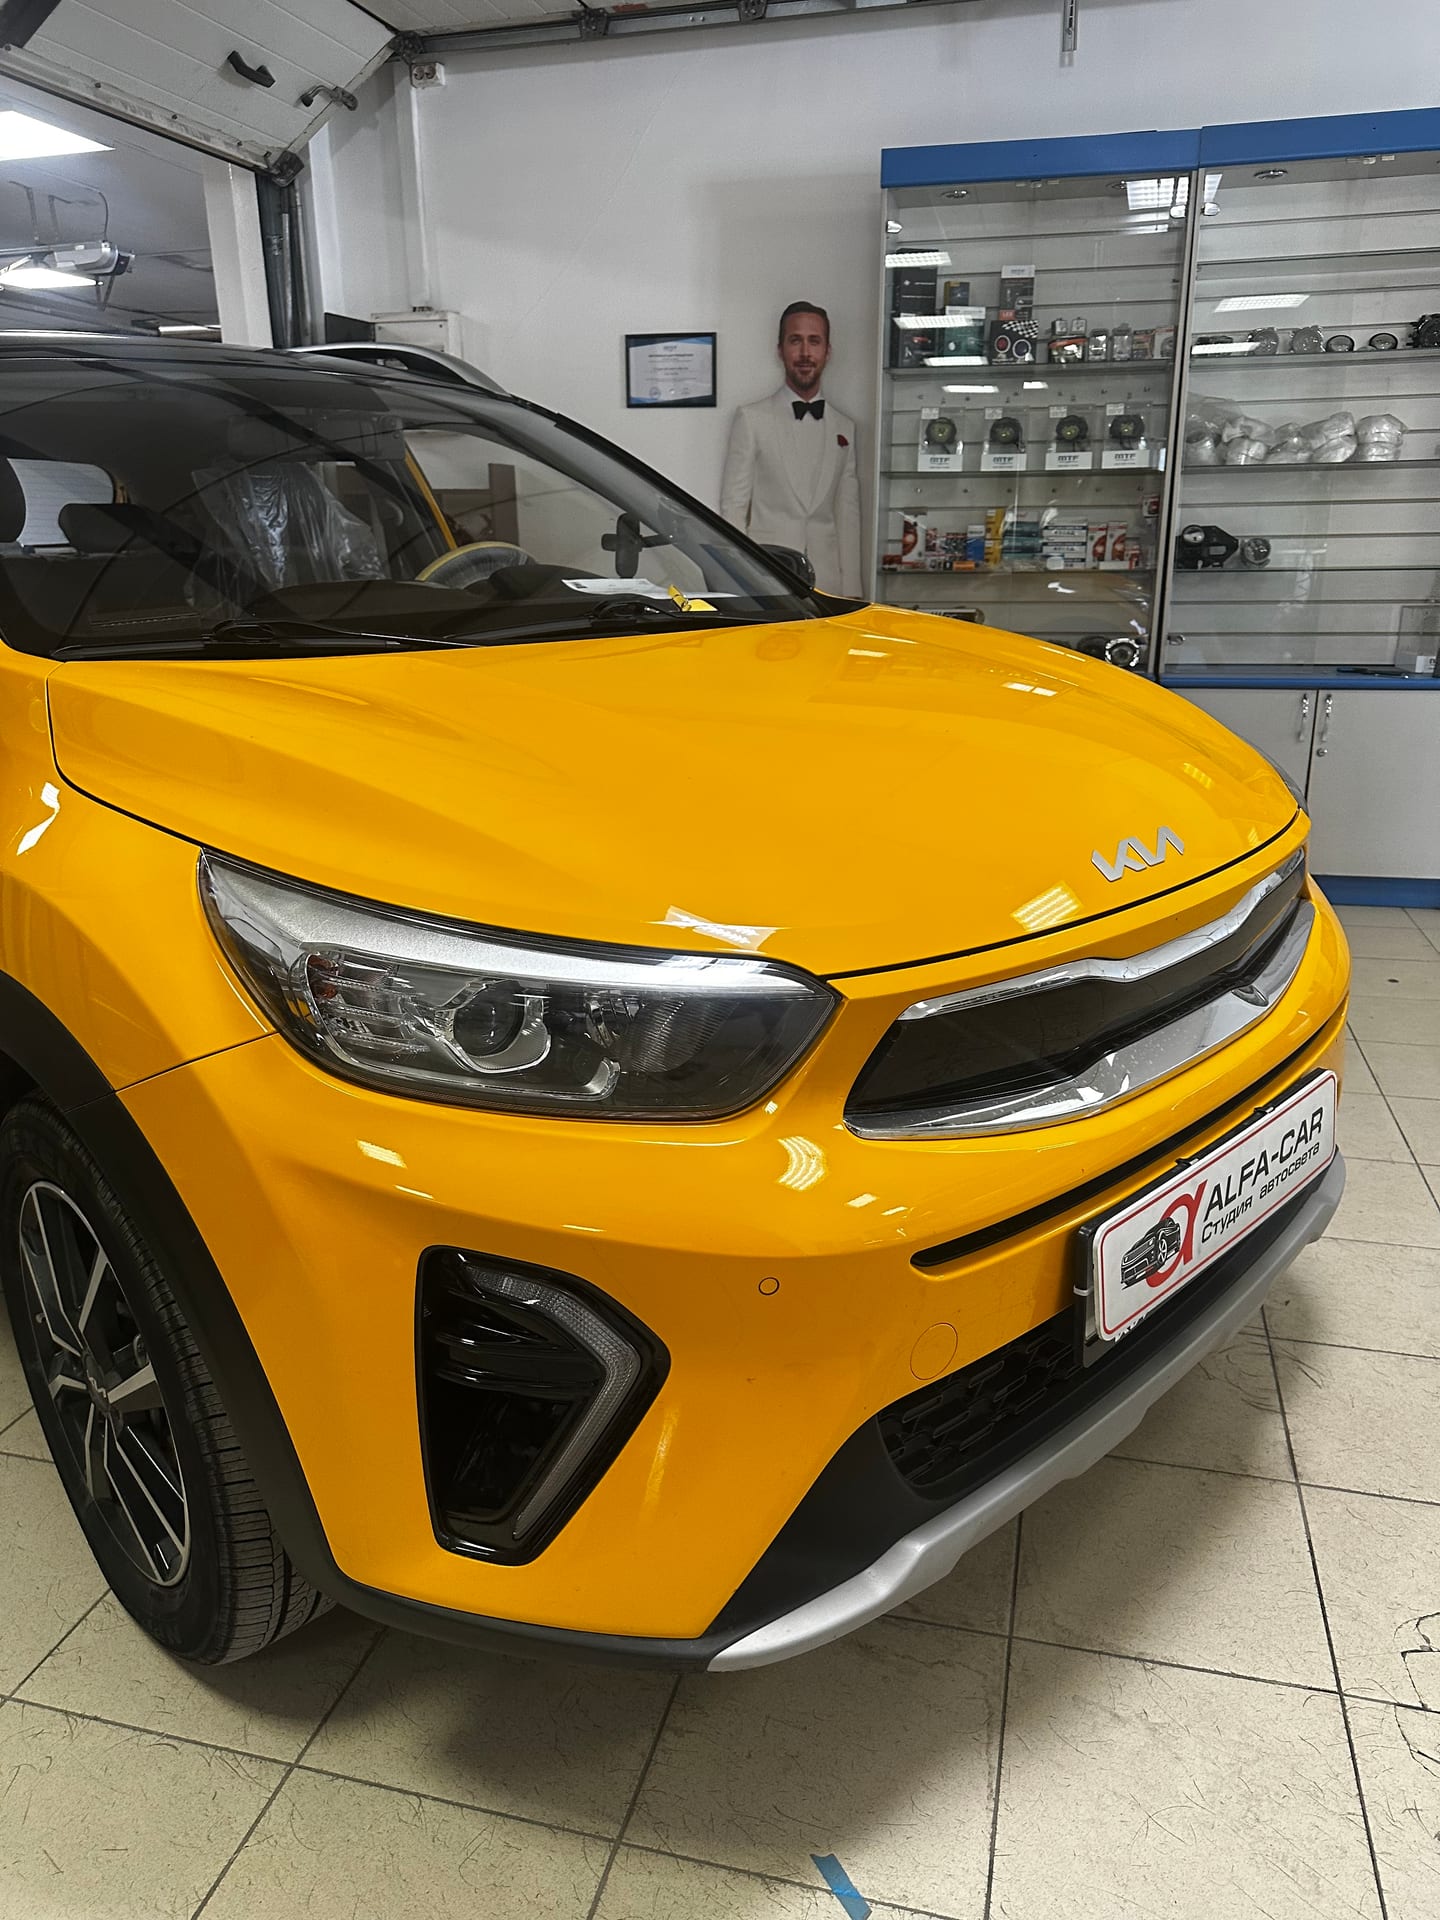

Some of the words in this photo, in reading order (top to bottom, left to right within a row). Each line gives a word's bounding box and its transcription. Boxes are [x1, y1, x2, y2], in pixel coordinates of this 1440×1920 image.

[1201, 1196, 1253, 1244] Студия
[1259, 1142, 1320, 1200] автосвета
[1203, 1106, 1324, 1223] ALFA-CAR
